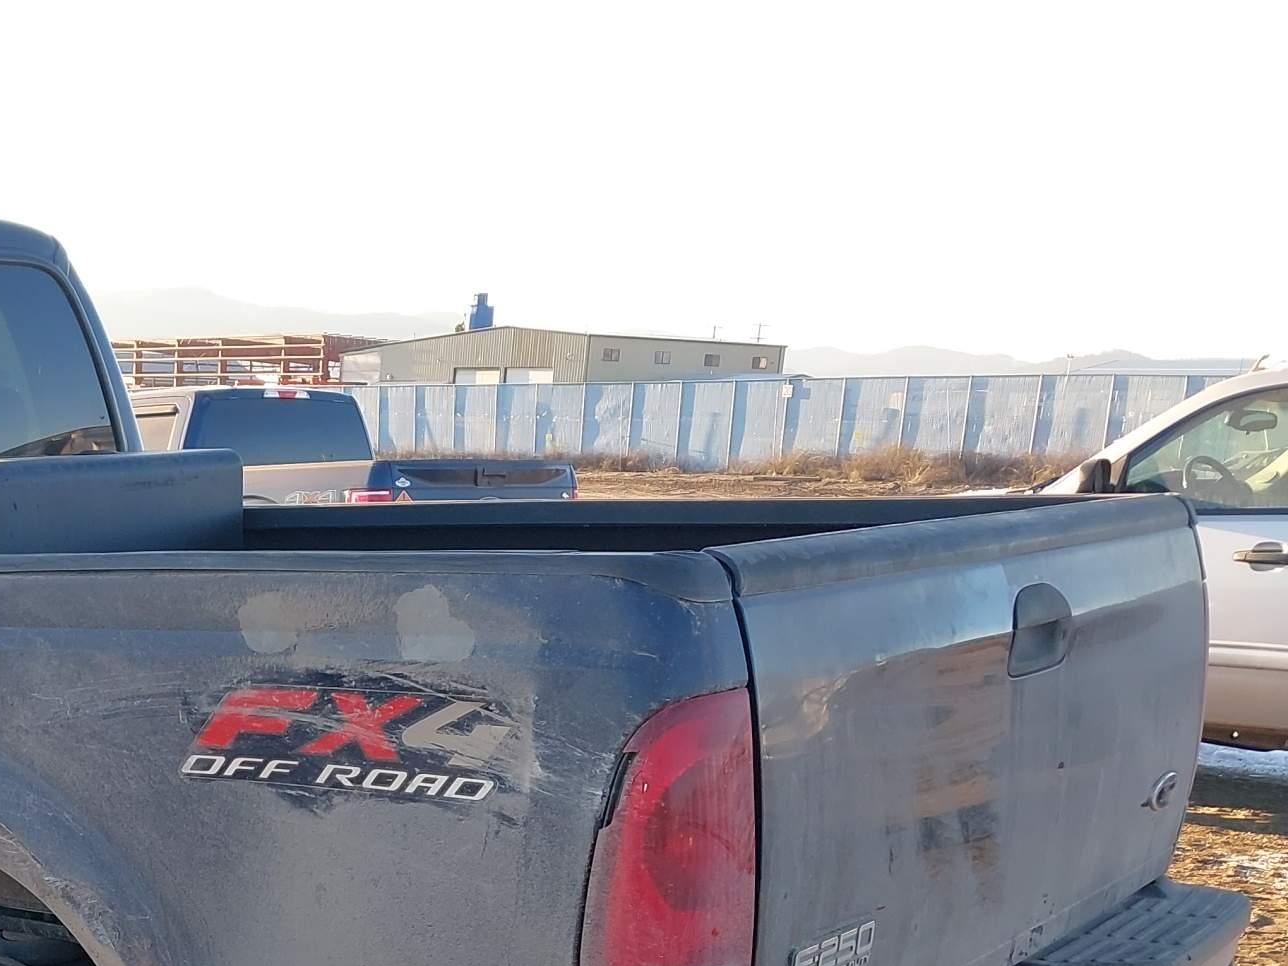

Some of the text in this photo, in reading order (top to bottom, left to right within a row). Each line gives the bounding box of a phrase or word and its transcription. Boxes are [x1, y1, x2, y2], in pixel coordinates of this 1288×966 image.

[195, 687, 511, 767] FX4
[180, 754, 495, 800] OFF ROAD
